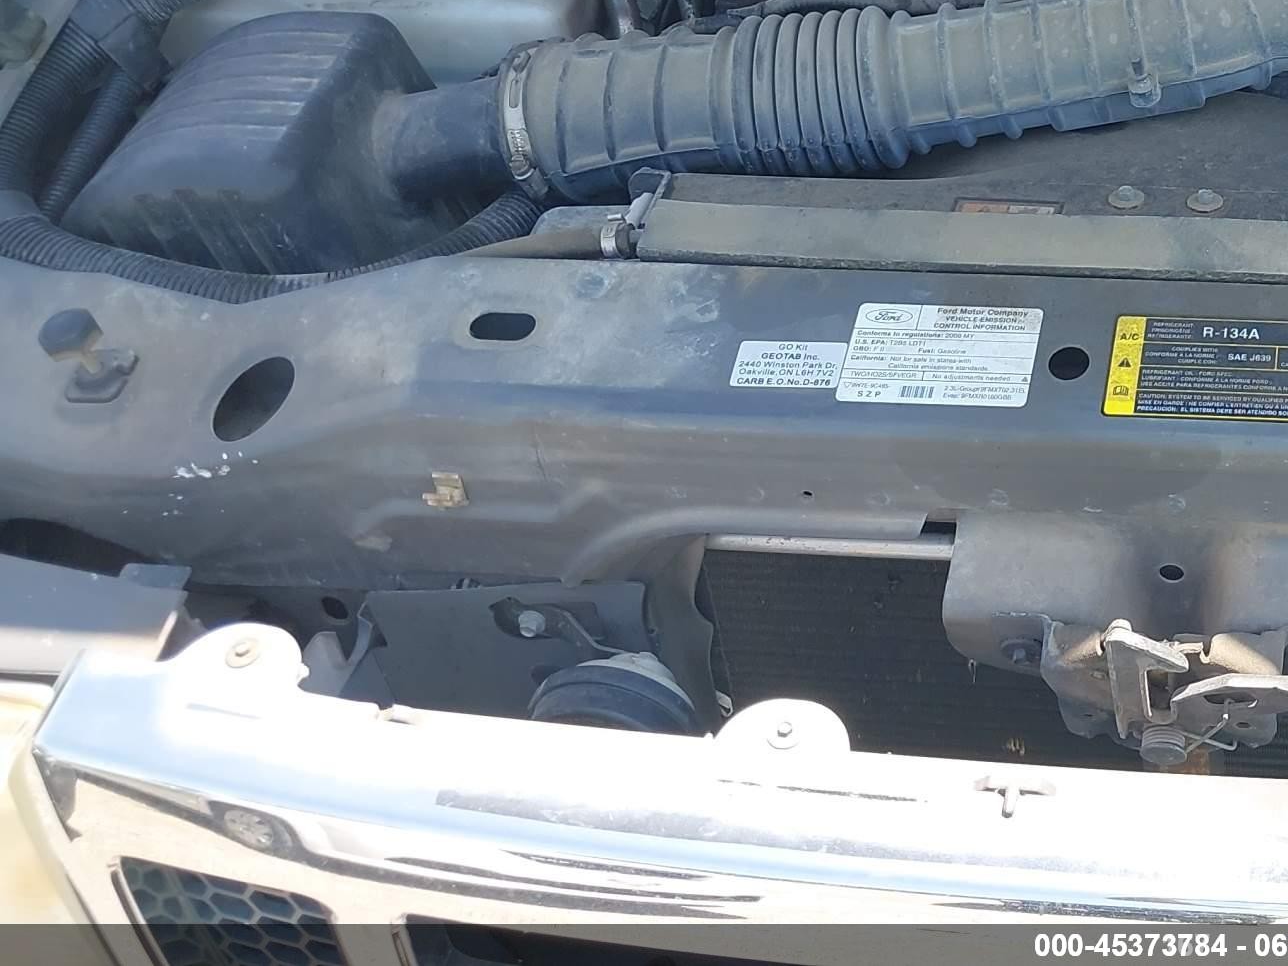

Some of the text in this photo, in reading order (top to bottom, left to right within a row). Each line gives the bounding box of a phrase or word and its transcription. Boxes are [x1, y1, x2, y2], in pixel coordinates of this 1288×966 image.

[875, 311, 903, 321] Ford
[988, 309, 1028, 318] Company
[1202, 326, 1260, 340] R-134A
